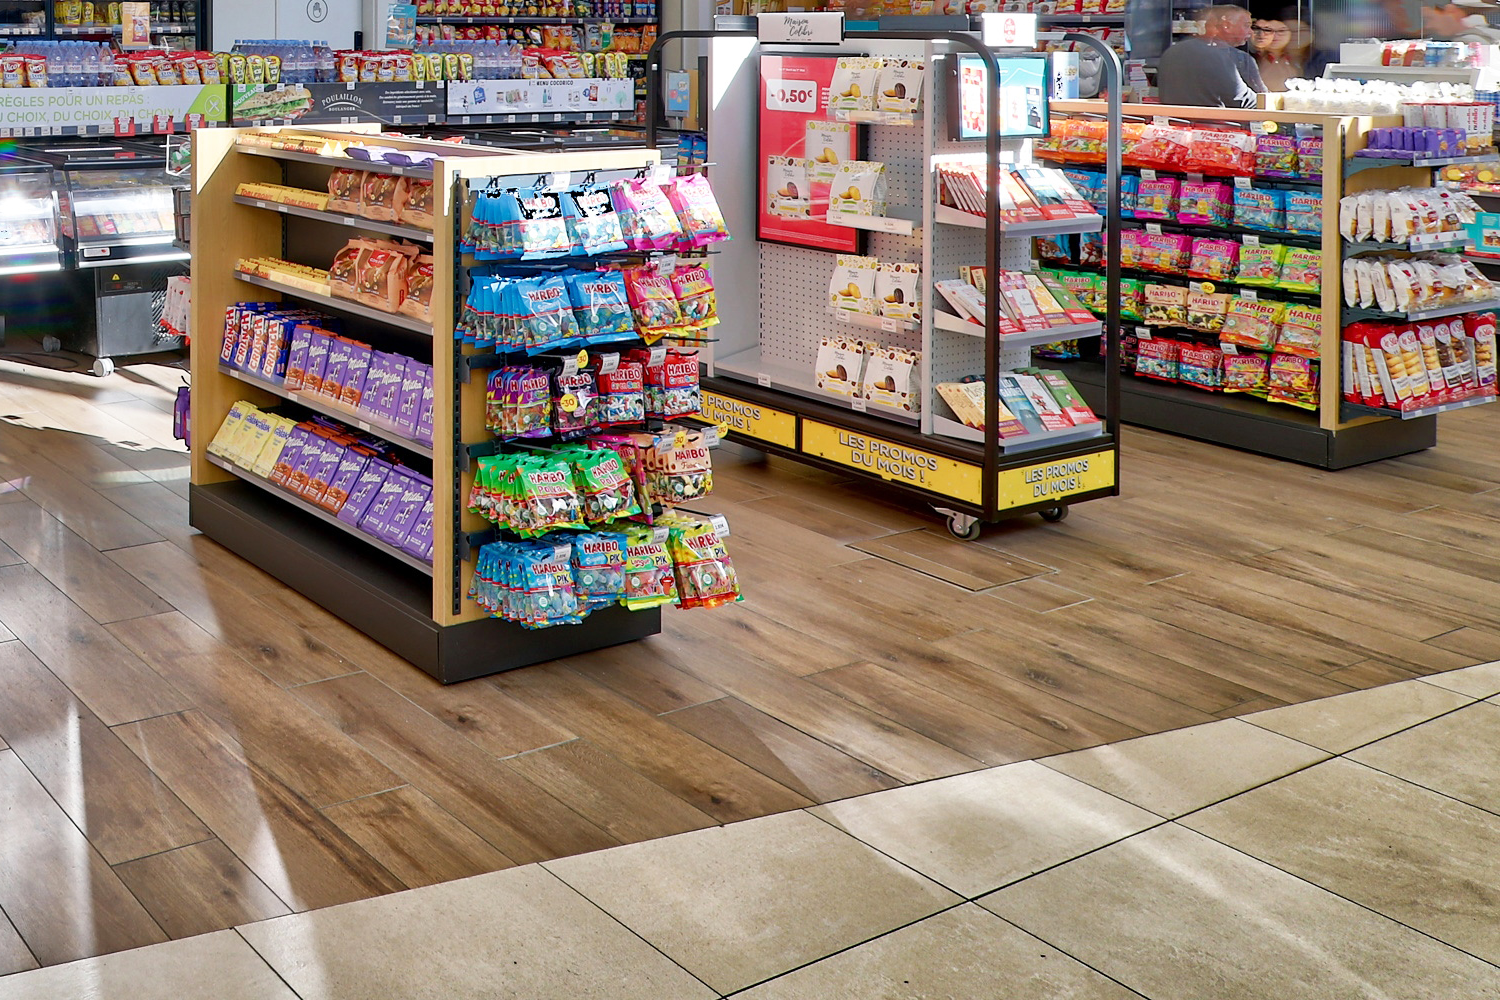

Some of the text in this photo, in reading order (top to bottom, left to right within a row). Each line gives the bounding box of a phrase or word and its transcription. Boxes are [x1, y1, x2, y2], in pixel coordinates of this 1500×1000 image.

[784, 16, 809, 26] Maison
[789, 25, 813, 36] Colibri
[48, 96, 83, 106] POUR
[86, 96, 102, 105] UN
[106, 95, 144, 105] REPAS
[321, 94, 364, 105] POULAILLON
[8, 111, 50, 123] CHOIX,
[54, 111, 72, 122] DU
[118, 110, 134, 119] DU
[135, 109, 175, 120] CHOIX
[1200, 131, 1235, 139] HARIBO
[1259, 139, 1292, 147] HARIBO
[240, 187, 273, 200] TOBLERONE
[1239, 192, 1271, 201] HARIBO
[283, 195, 319, 210] TOBLERONE
[1149, 236, 1177, 244] HARIBO
[1200, 243, 1227, 251] HARIBO
[1235, 301, 1274, 314] HARIBO
[222, 307, 235, 360] CRUNCH
[236, 312, 250, 366] CRUNCH
[249, 316, 264, 371] CRUNCH
[264, 320, 279, 377] CRUNCH
[329, 351, 348, 363] Milka
[576, 355, 587, 364] -30
[348, 357, 368, 370] Milka
[667, 363, 698, 375] HARIBO
[610, 368, 641, 381] HARIBO
[403, 377, 423, 391] Milka
[562, 398, 575, 406] -30
[708, 395, 762, 421] PROMOS
[713, 407, 745, 430] MOIS
[674, 435, 684, 444] -30
[320, 451, 339, 463] Milka
[675, 449, 705, 461] HARIBO
[839, 432, 938, 471] LES PROMOS
[339, 460, 360, 472] Milka
[851, 450, 925, 483] DU MOIS !
[1025, 458, 1089, 485] LES PROMOS
[360, 472, 381, 483] Milka
[380, 482, 402, 494] Milka
[1033, 476, 1082, 497] DU MOIS !
[584, 540, 619, 553] HARIBO
[627, 545, 662, 556] HARIBO
